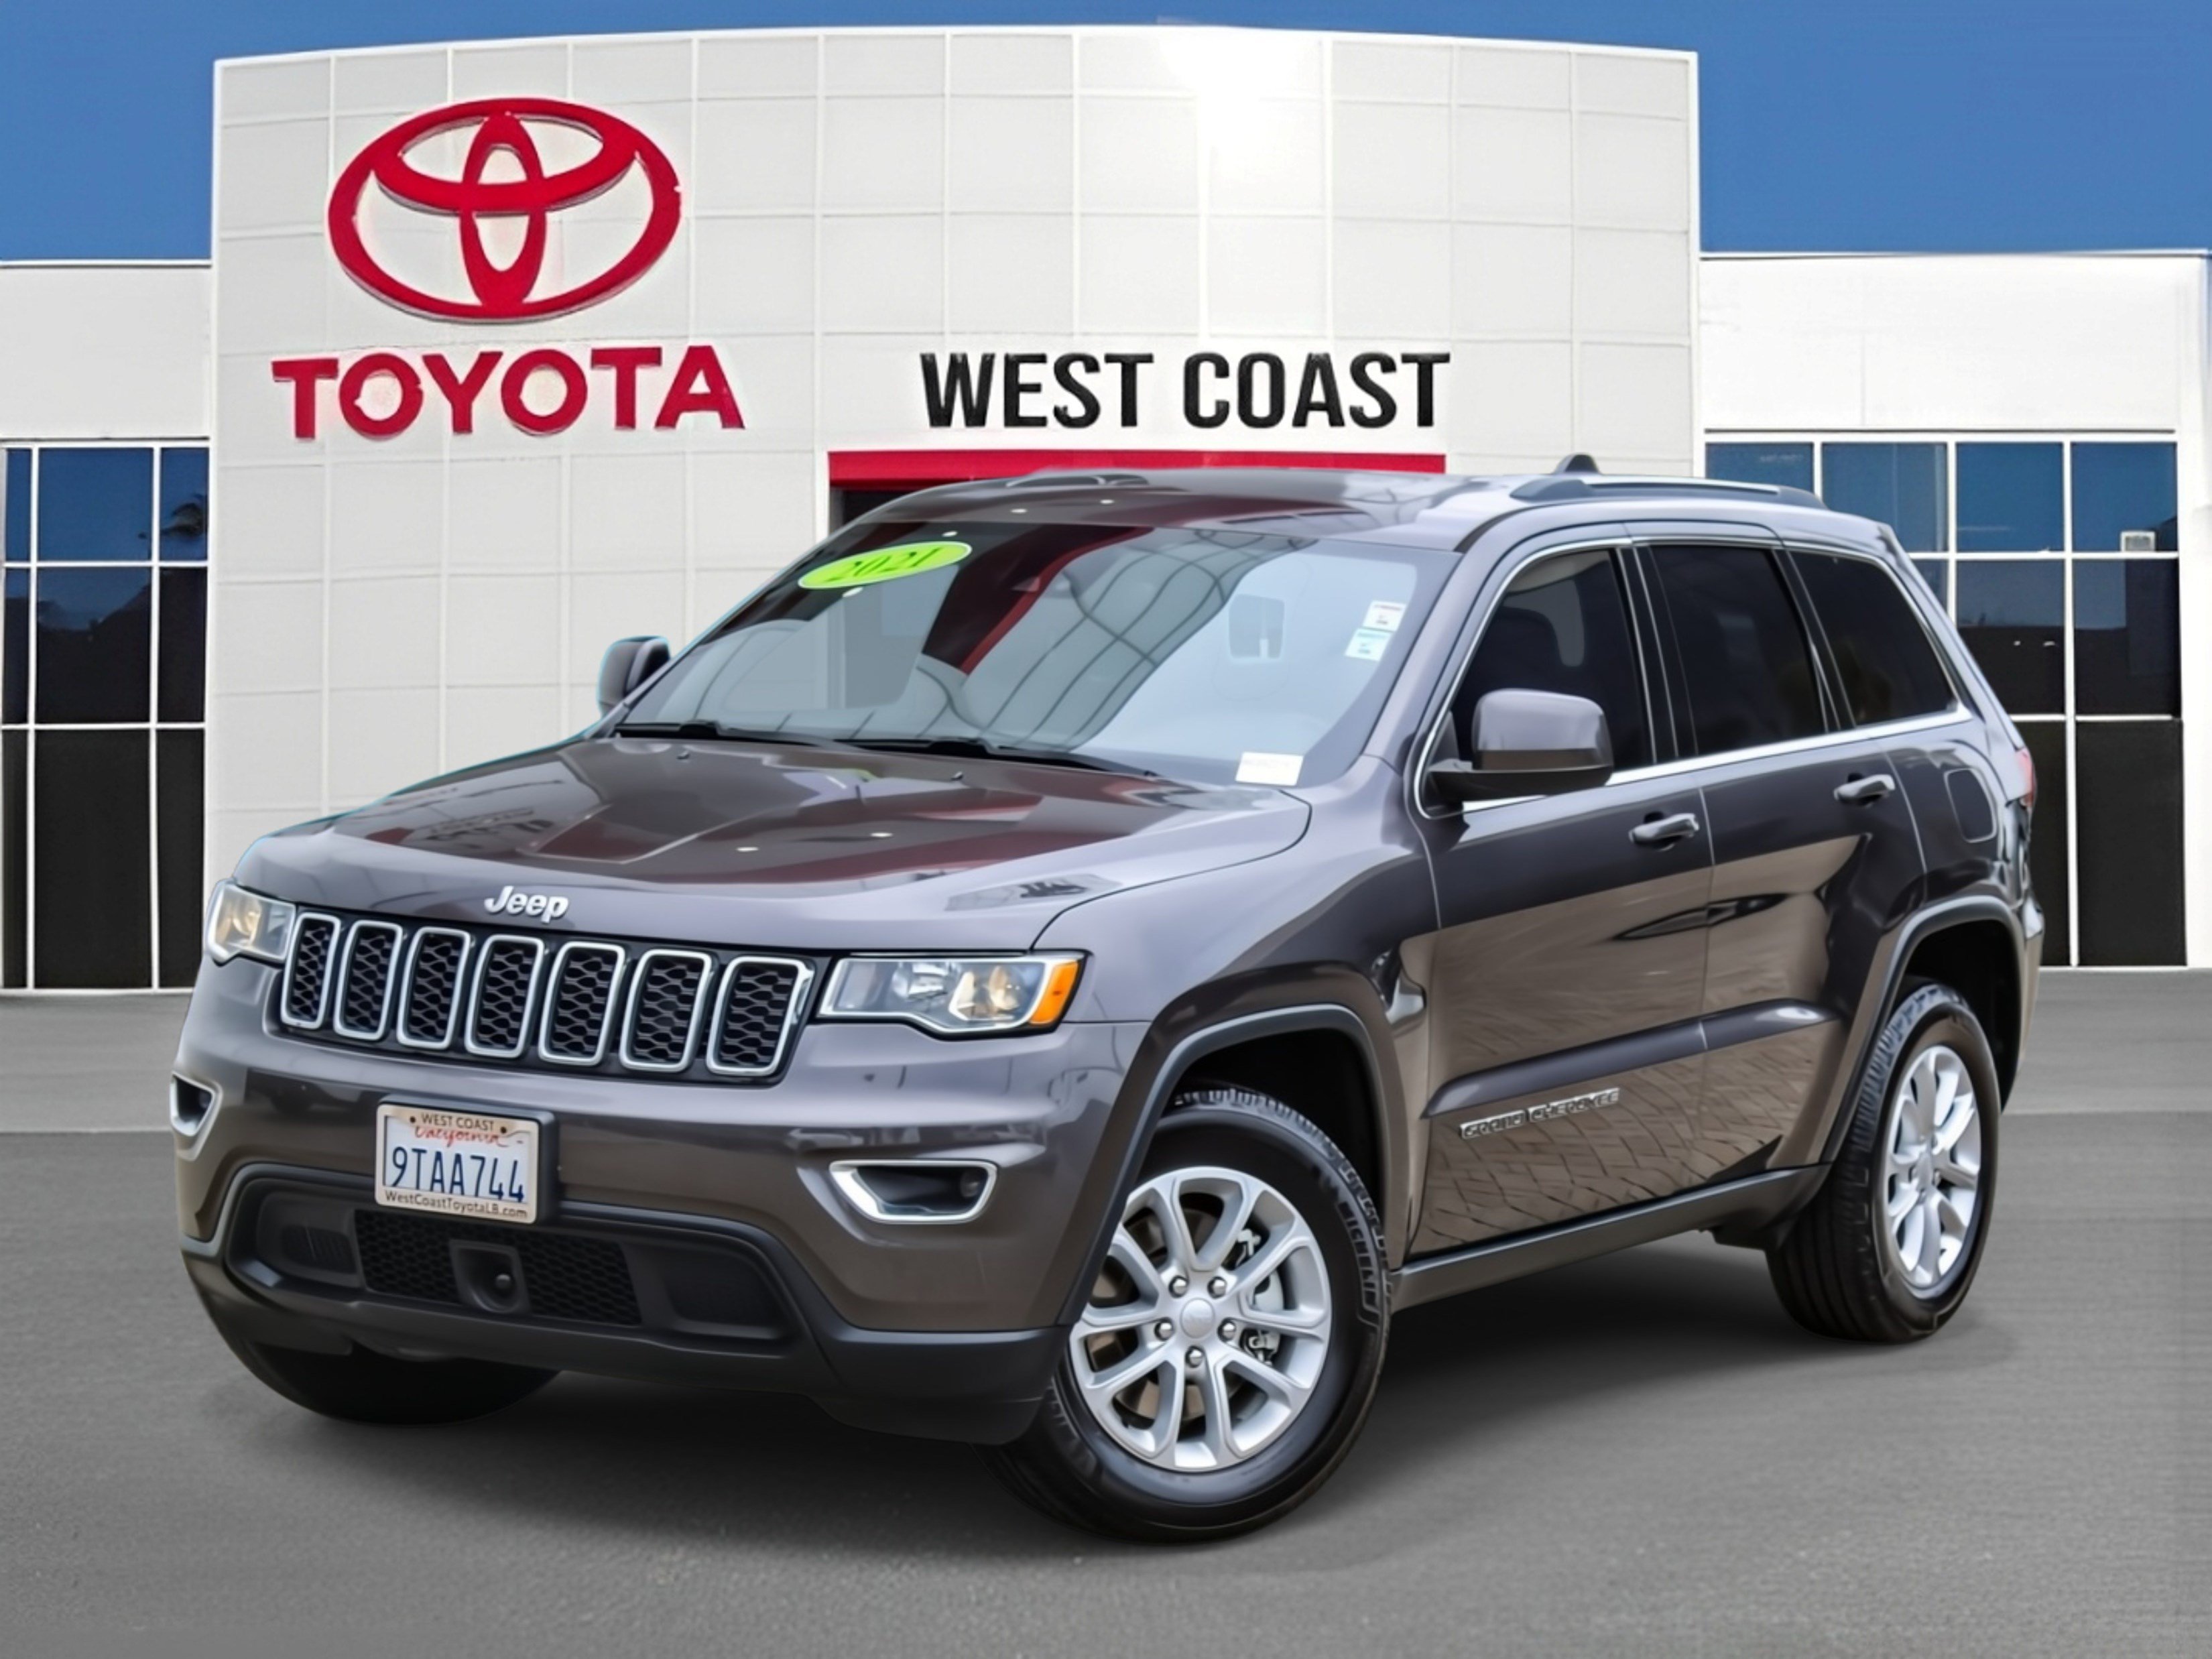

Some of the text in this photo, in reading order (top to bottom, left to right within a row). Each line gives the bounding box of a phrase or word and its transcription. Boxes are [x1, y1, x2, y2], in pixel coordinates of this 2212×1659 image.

[271, 345, 744, 440] TOYOTA
[920, 353, 1451, 429] WEST COAST
[822, 547, 943, 582] 2021
[484, 885, 569, 924] Jeep
[422, 1113, 495, 1131] WEST COAST
[392, 1146, 524, 1203] 9TAA744
[384, 1189, 528, 1219] WestCoastToyotaLB.com
